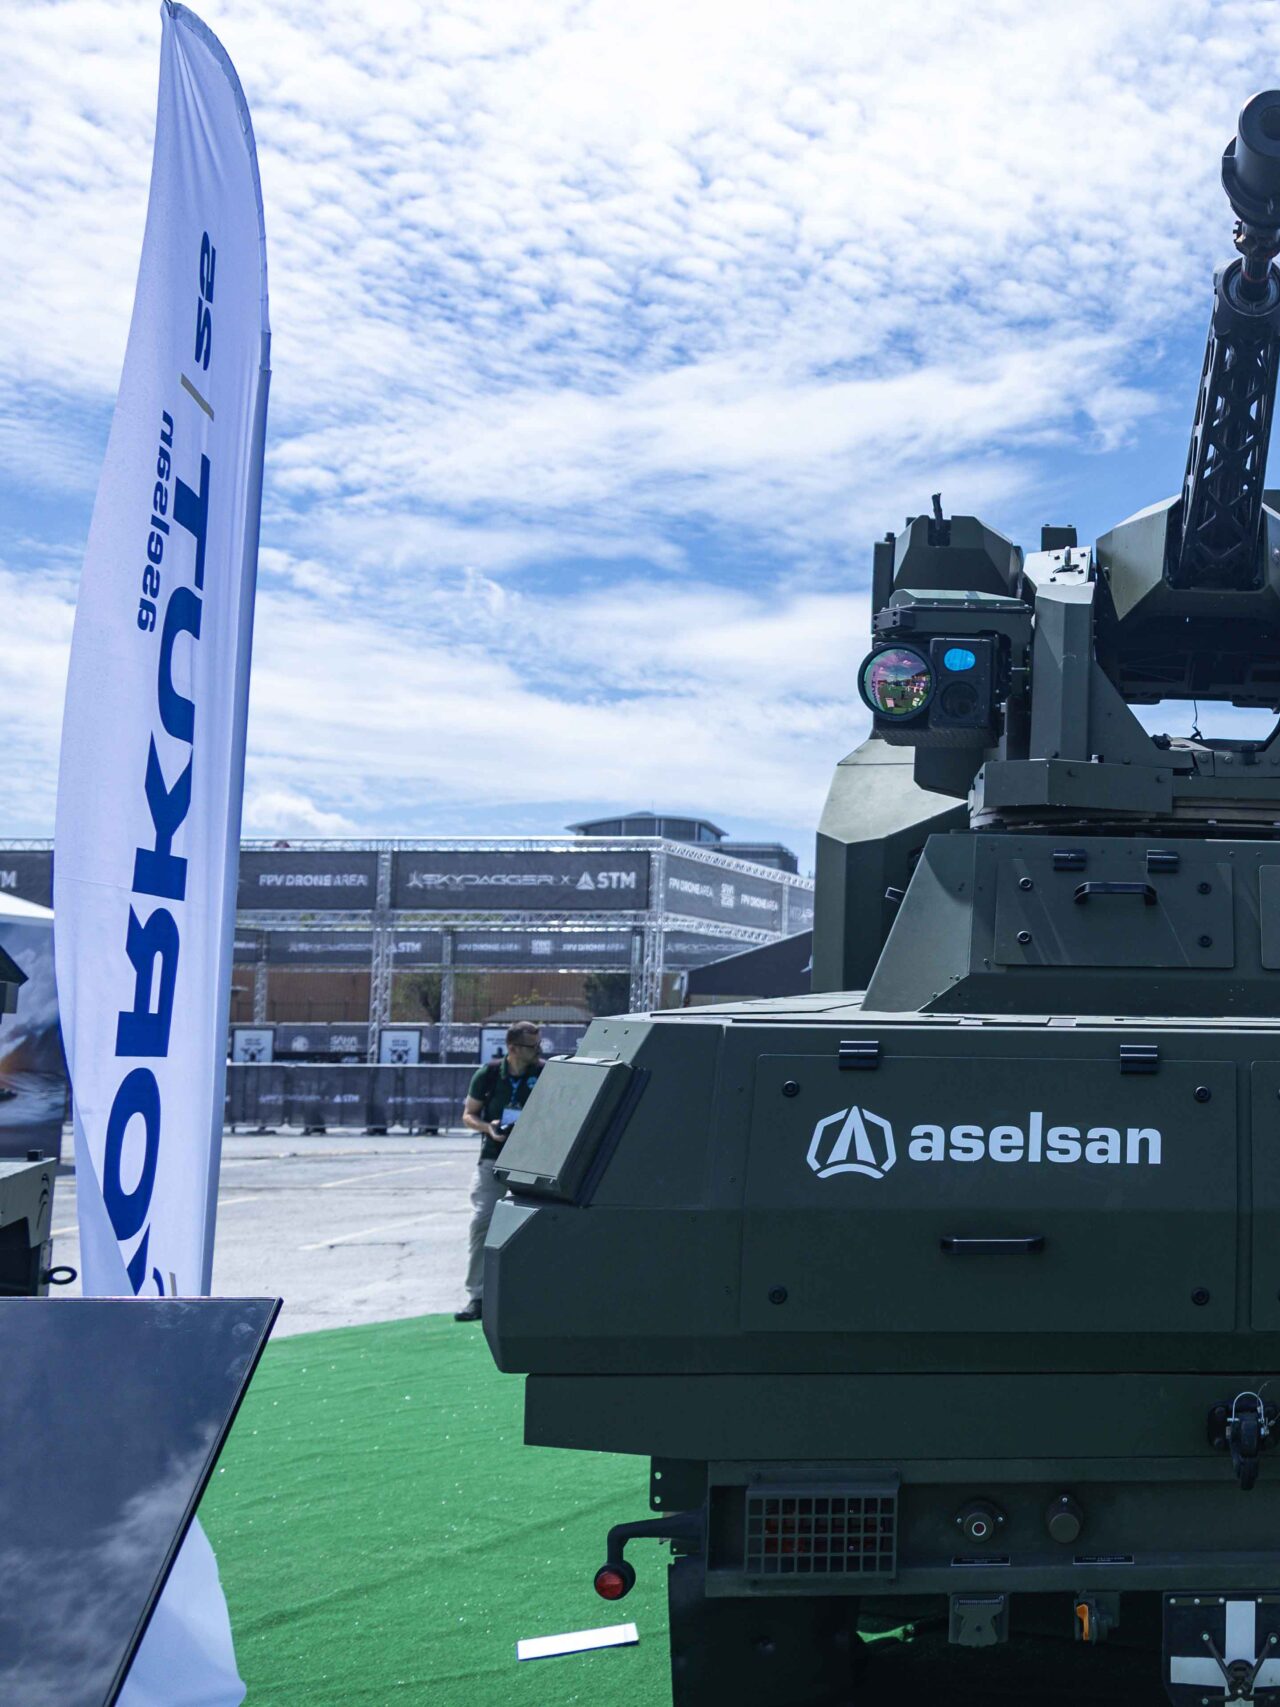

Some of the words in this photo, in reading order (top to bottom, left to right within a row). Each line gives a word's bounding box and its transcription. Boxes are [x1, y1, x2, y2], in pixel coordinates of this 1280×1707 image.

[259, 874, 284, 886] FPV
[285, 874, 332, 887] DRONE
[333, 874, 368, 887] AREA
[597, 871, 637, 888] STM
[908, 1111, 1162, 1165] aselsan
